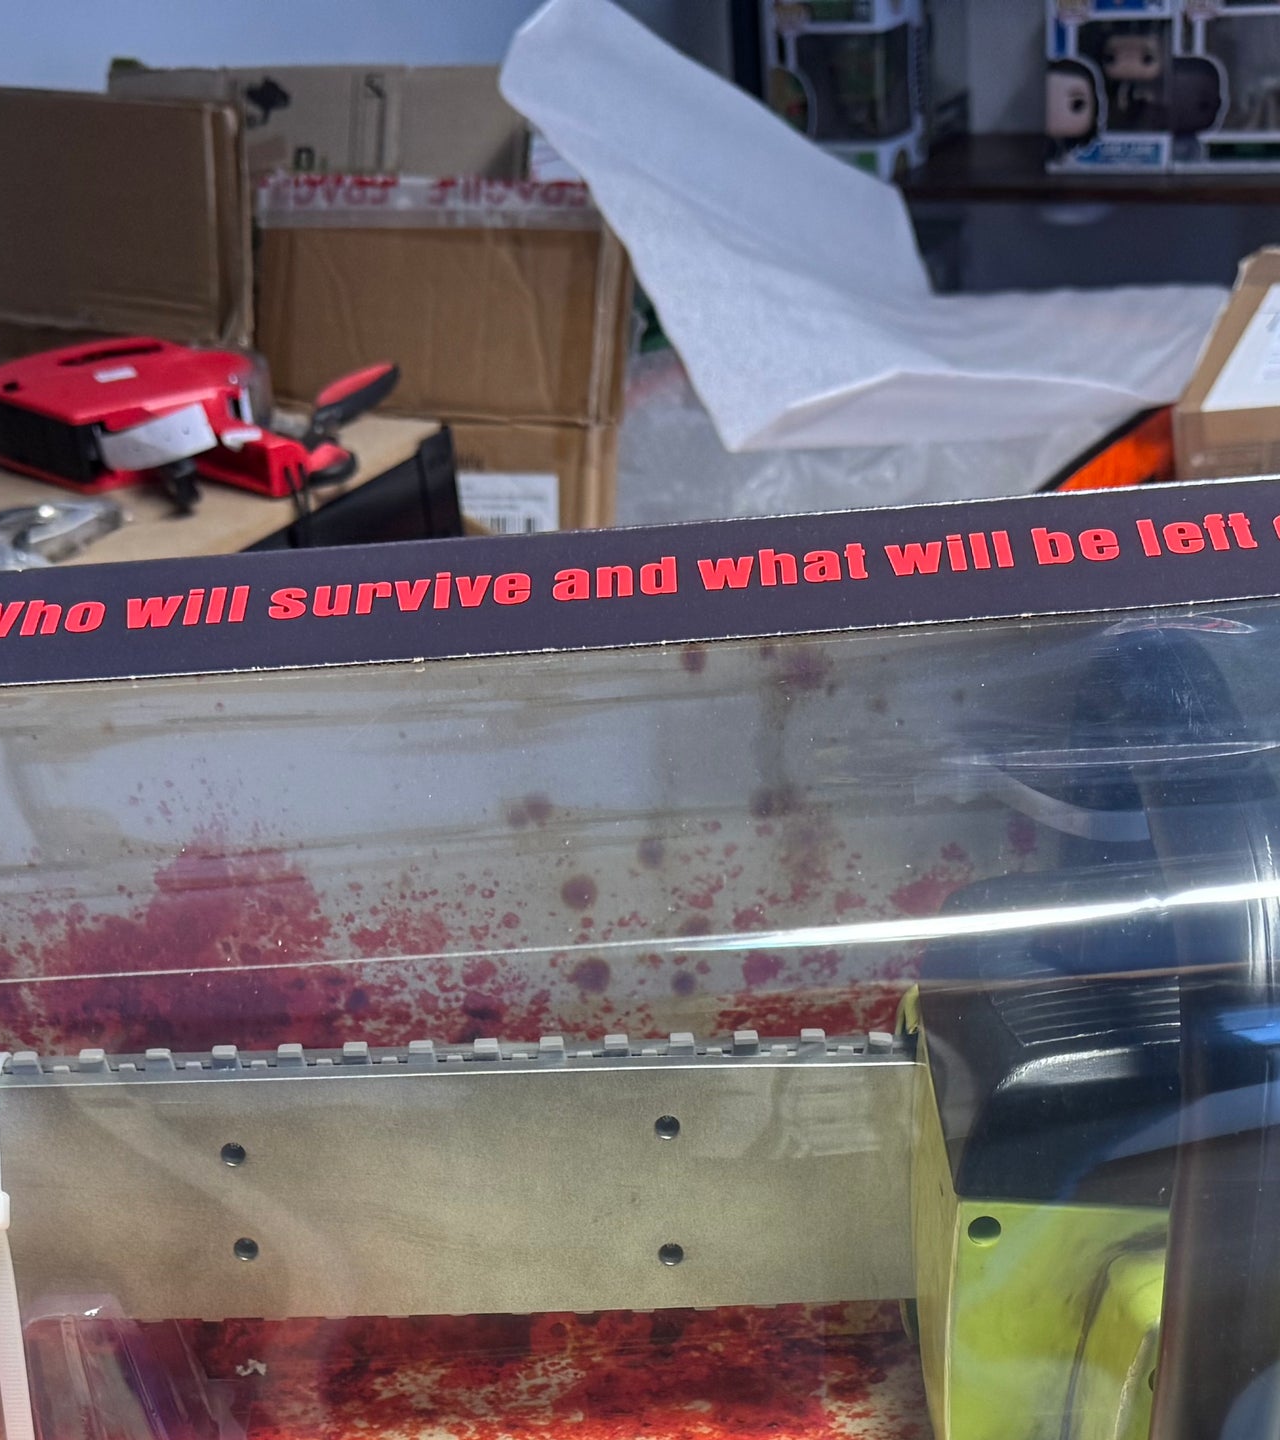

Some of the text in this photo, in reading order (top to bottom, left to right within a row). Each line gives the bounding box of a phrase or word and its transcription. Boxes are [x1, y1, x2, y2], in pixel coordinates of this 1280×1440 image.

[126, 585, 250, 631] will
[269, 571, 532, 620] survive
[552, 556, 679, 602] and
[698, 543, 869, 591] what
[884, 531, 1014, 577] will
[1031, 527, 1120, 566] be
[1136, 512, 1258, 558] left
